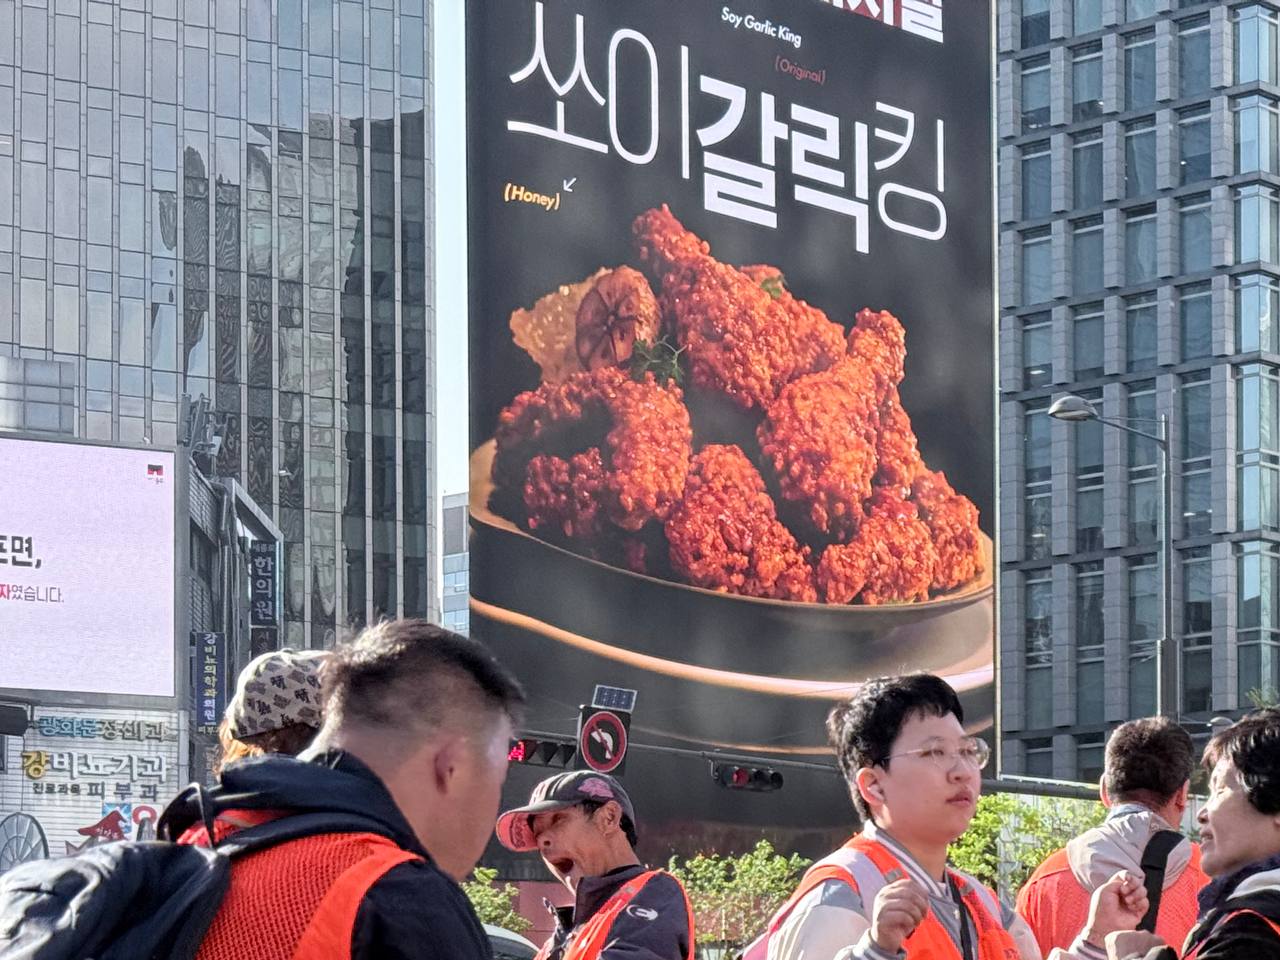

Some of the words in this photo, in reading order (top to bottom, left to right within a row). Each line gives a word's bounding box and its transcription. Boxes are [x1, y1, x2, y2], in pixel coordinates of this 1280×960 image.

[721, 6, 742, 28] Soy
[744, 14, 776, 37] Garlic
[778, 25, 801, 48] King
[504, 182, 560, 210] (Honey)
